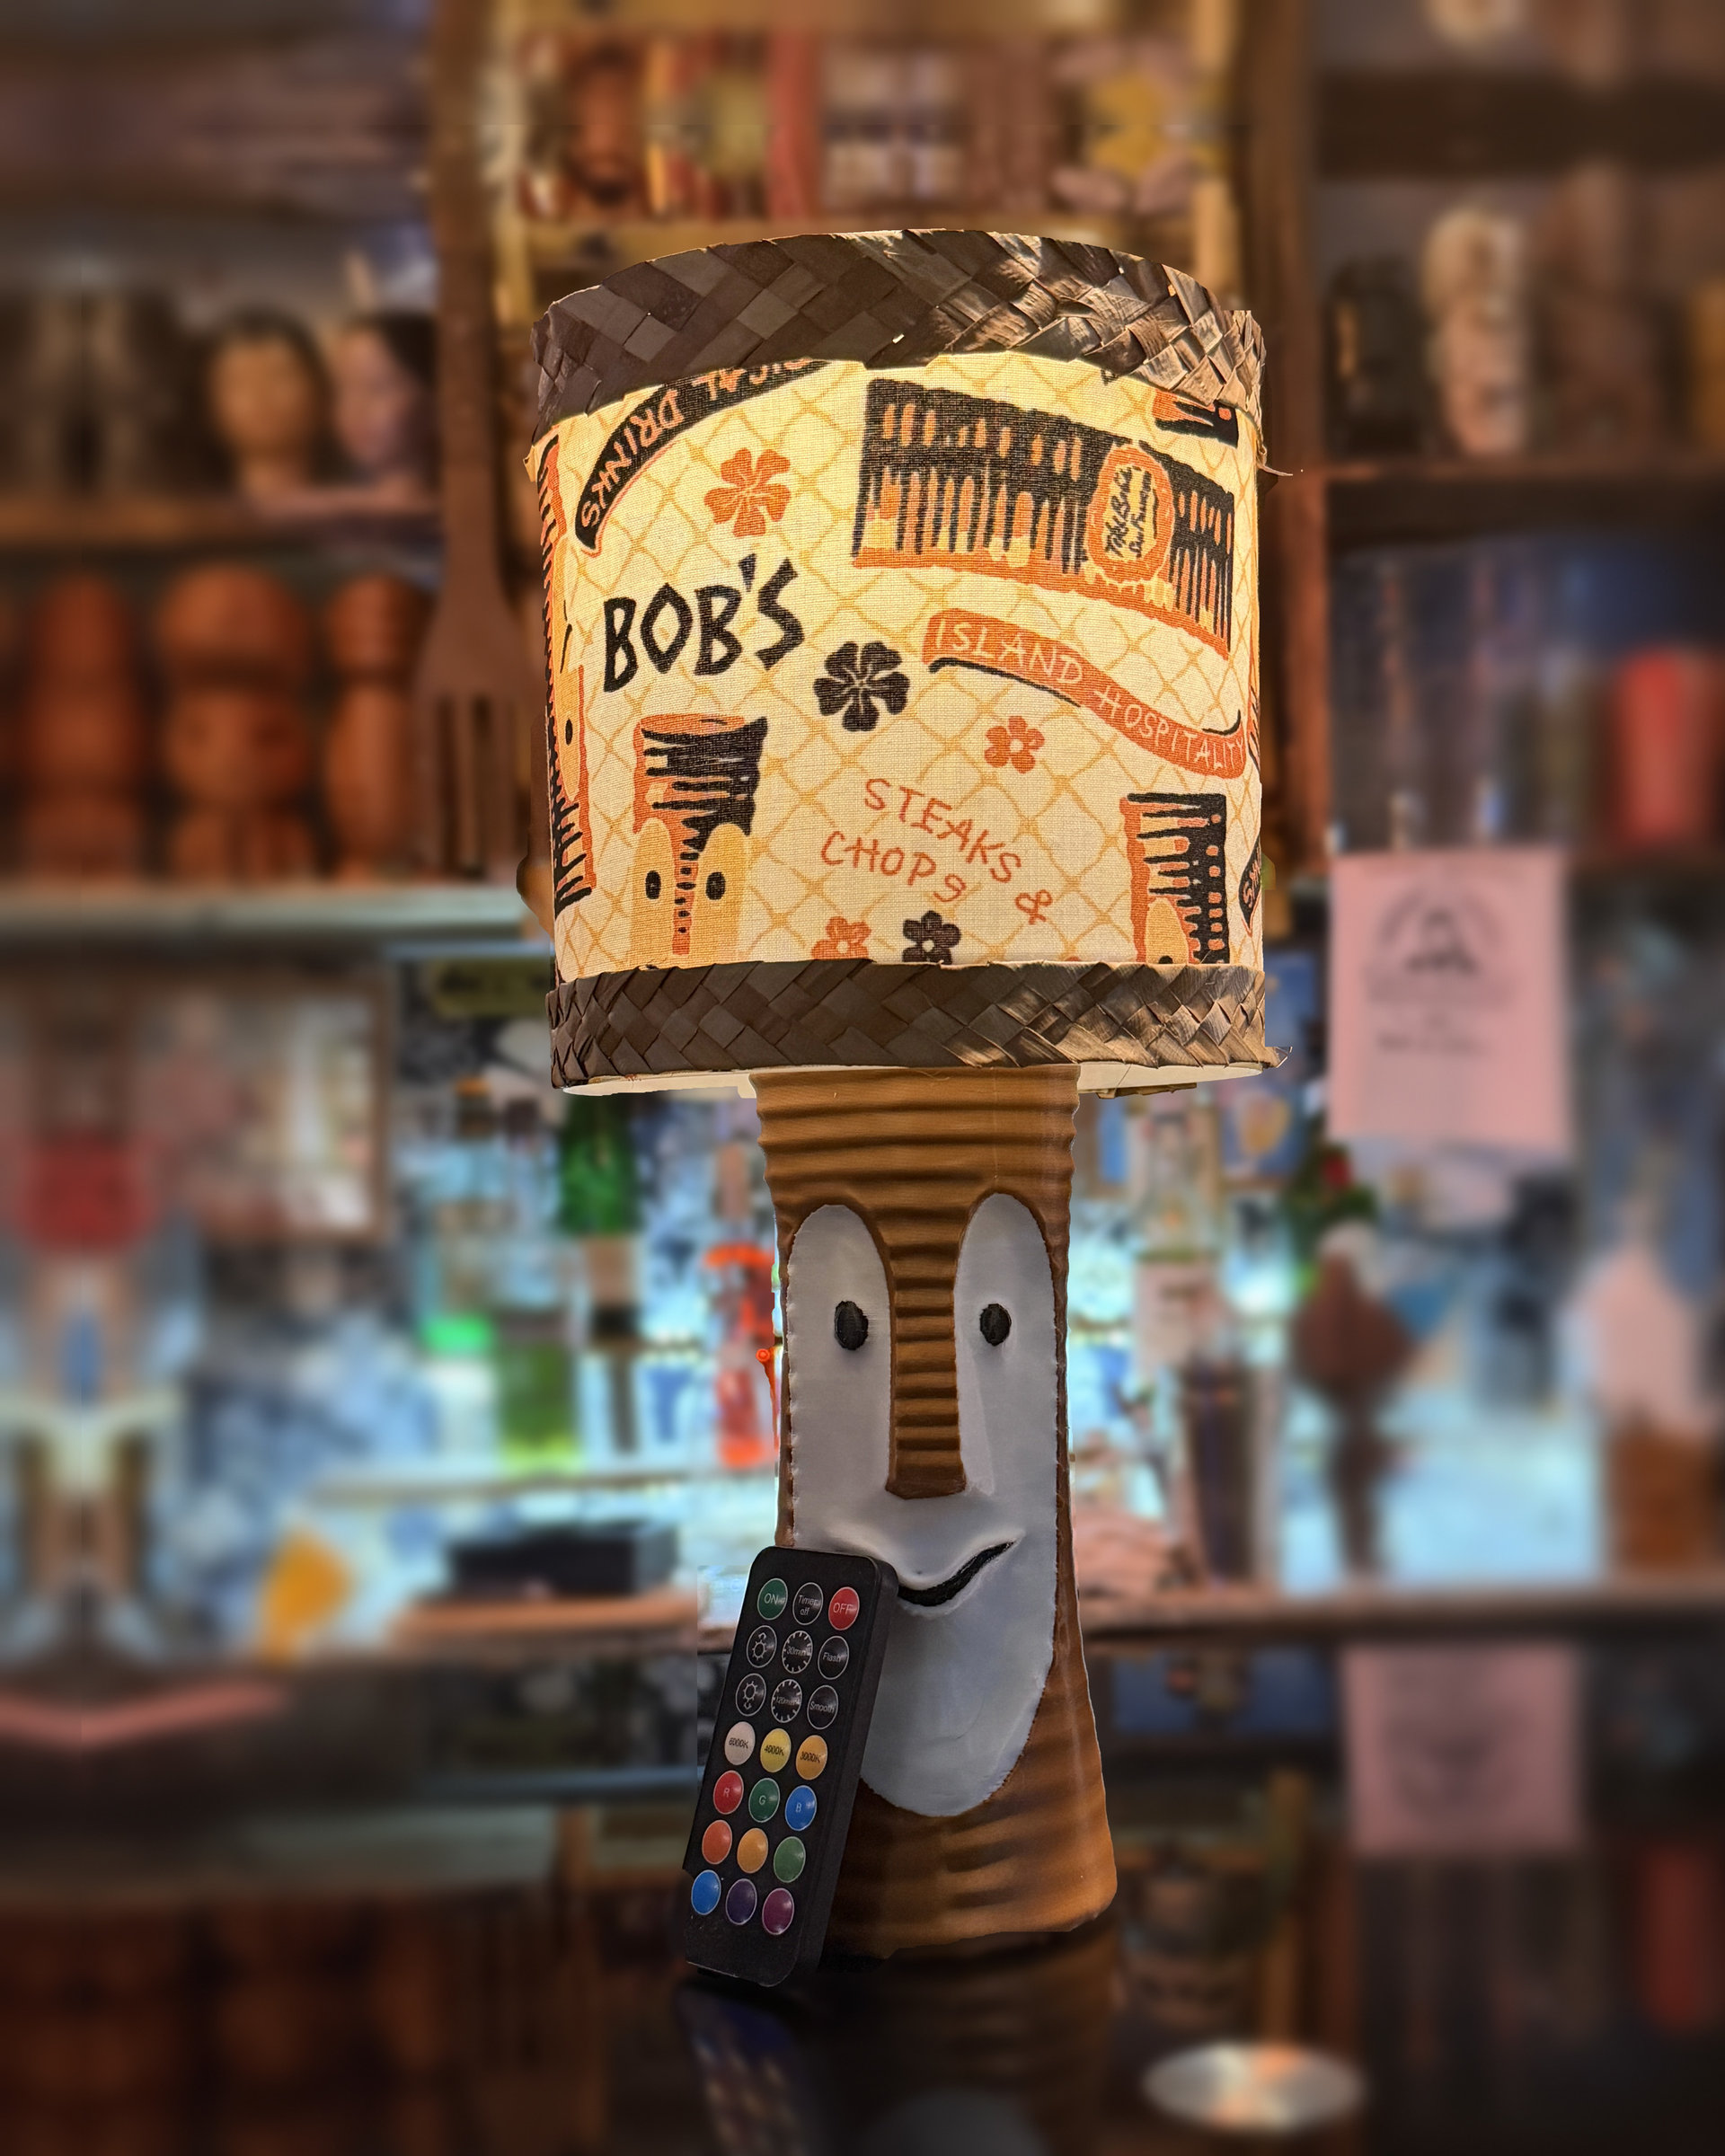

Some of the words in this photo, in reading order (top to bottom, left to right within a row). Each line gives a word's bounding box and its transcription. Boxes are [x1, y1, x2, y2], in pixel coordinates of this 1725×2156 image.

[580, 389, 685, 528] DRINKS
[603, 553, 805, 693] BOB'S
[935, 620, 1083, 685] ISLAND
[1093, 685, 1245, 770] HOSPITALITY
[864, 778, 1022, 883] STEAKS
[764, 1593, 778, 1604] ON
[833, 1602, 856, 1614] OFF
[822, 1651, 843, 1663] Flash
[809, 1701, 836, 1714] Smooth
[764, 1745, 784, 1756] 4000K
[723, 1788, 730, 1798] R
[758, 1795, 766, 1806] G
[795, 1802, 802, 1813] B
